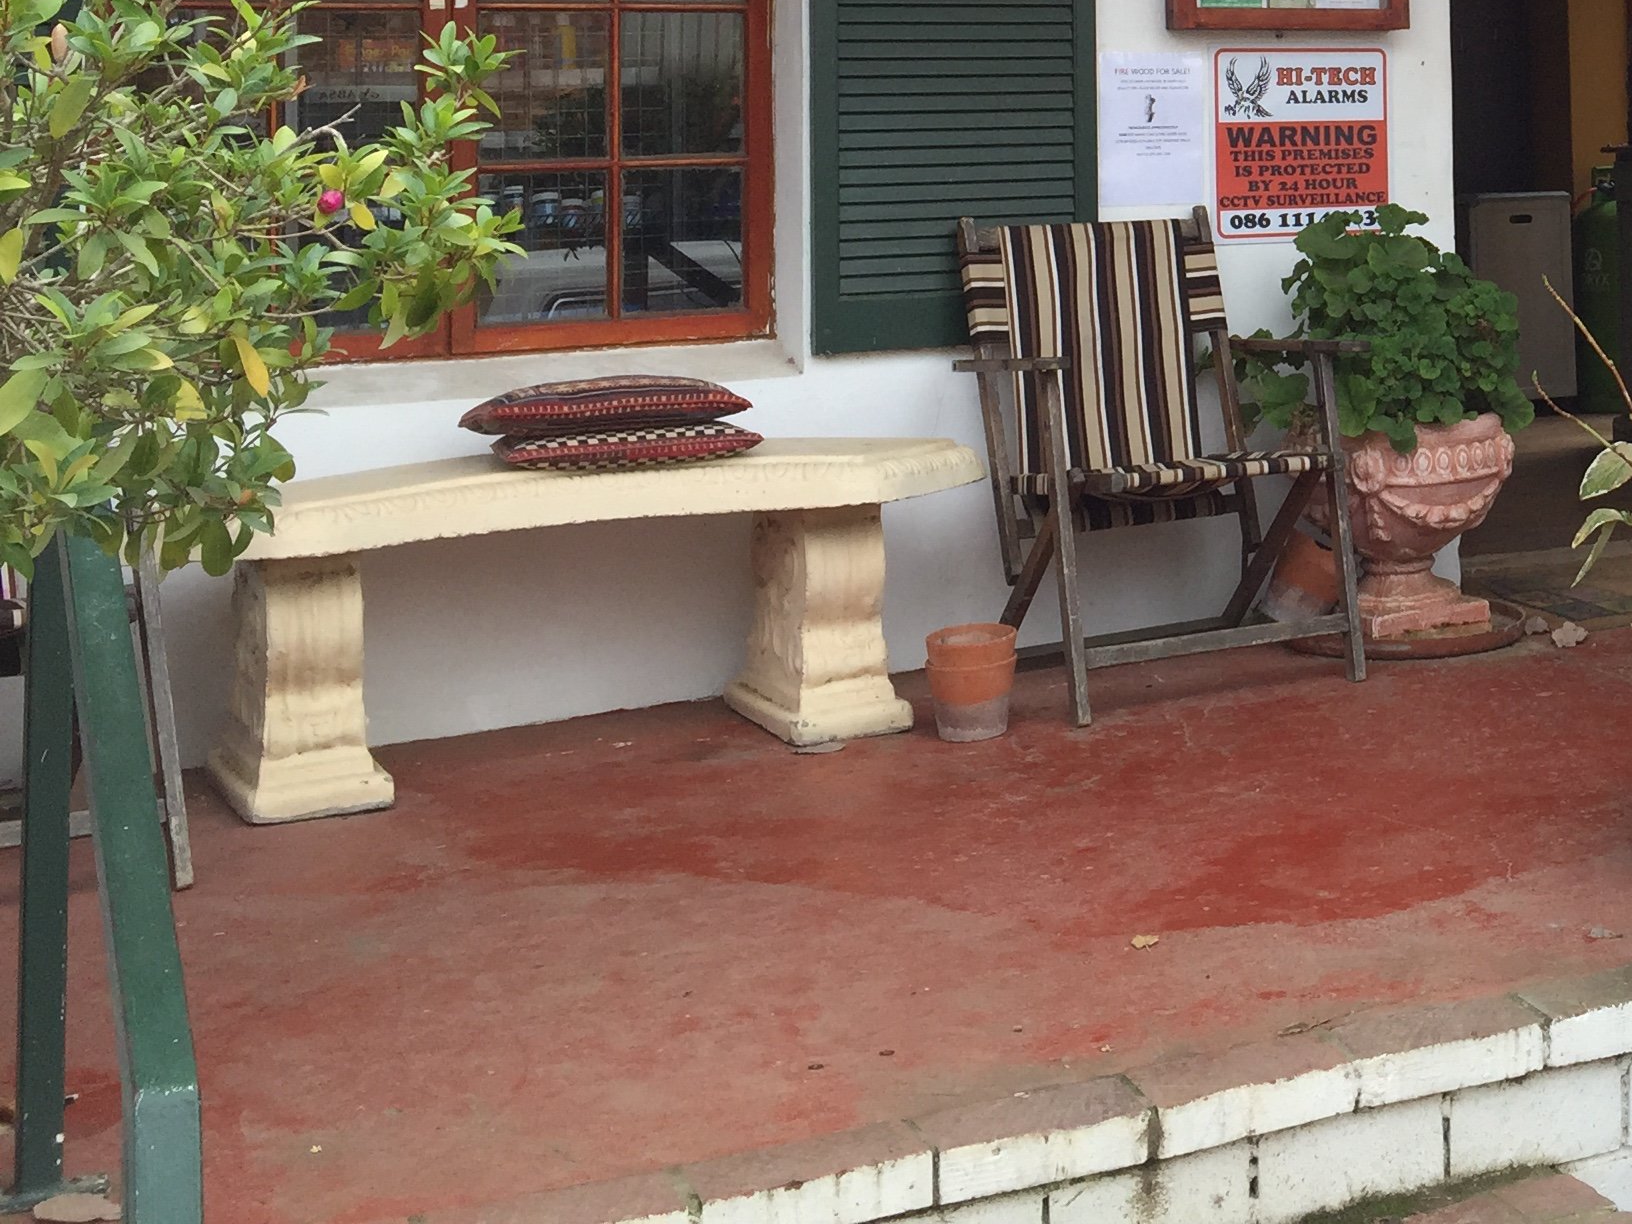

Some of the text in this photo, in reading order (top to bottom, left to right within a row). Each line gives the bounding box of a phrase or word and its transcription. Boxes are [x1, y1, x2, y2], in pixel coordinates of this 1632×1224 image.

[1276, 67, 1376, 86] HI-TECH
[1286, 89, 1368, 104] ALARMS
[1226, 125, 1377, 148] WARNING
[1230, 147, 1374, 162] THIS PREMISES
[1235, 162, 1370, 177] IS PROTECTED
[1248, 177, 1358, 192] BY 24 HOUR
[1219, 191, 1386, 208] CCTV SURVEILLANCE
[1230, 210, 1377, 230] 086 1113
